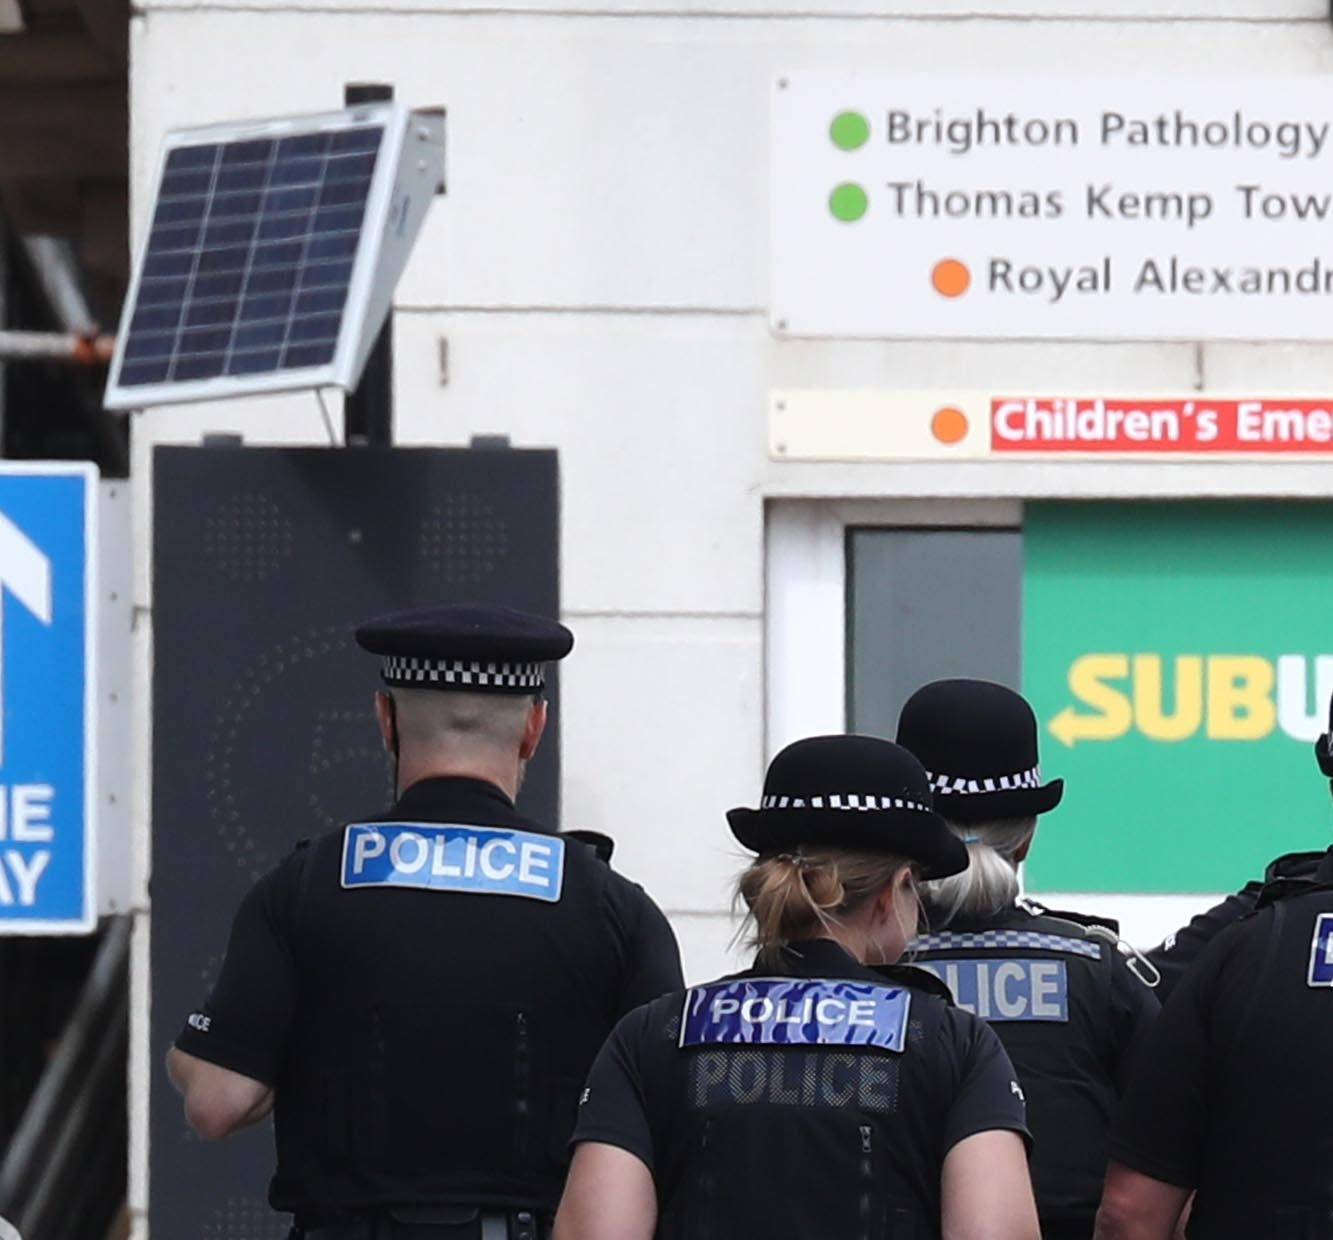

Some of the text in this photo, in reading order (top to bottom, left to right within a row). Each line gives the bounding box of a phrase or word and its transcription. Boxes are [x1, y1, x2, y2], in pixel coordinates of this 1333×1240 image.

[887, 109, 1329, 159] Brighton Pathology
[888, 180, 1064, 219] Thomas
[1086, 185, 1212, 229] Kemp
[988, 257, 1111, 303] Royal
[993, 401, 1218, 443] Children's
[353, 832, 551, 887] POLICE
[712, 997, 877, 1027] POLICE
[695, 1050, 893, 1112] POLICE
